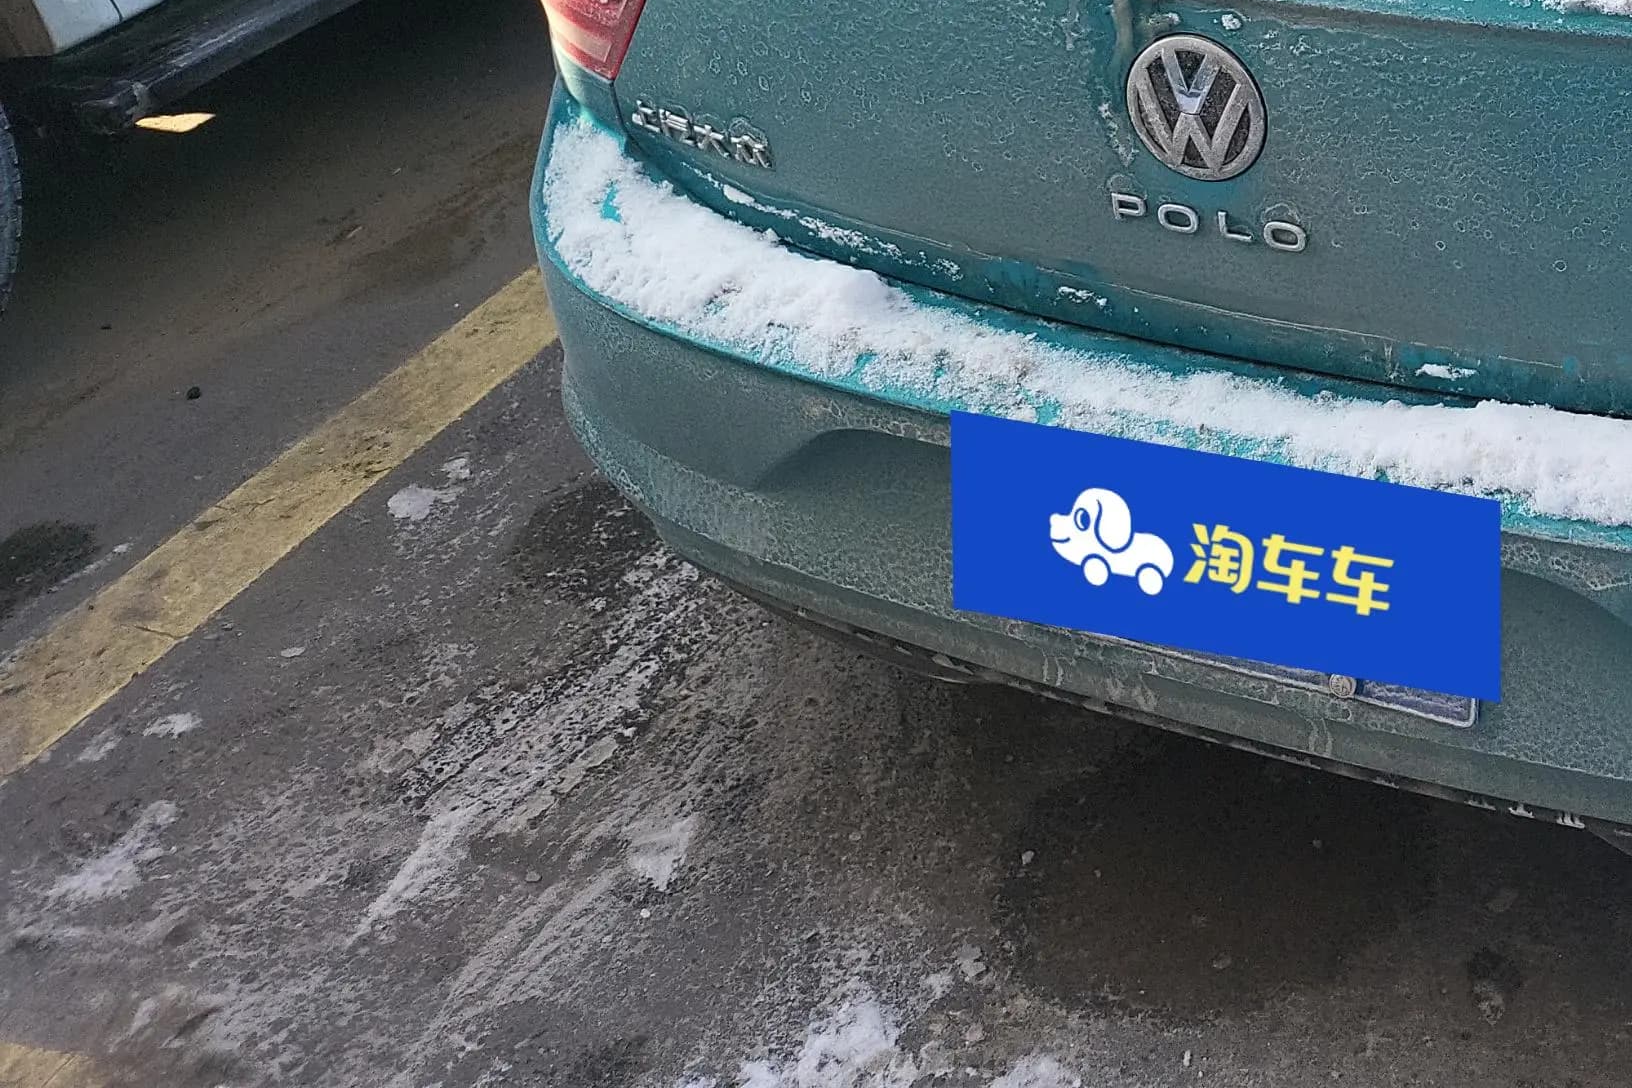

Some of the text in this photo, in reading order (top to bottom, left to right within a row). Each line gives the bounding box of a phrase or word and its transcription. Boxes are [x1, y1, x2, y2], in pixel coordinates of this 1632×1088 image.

[632, 99, 773, 168] 上汽大众
[1111, 193, 1306, 252] POLO
